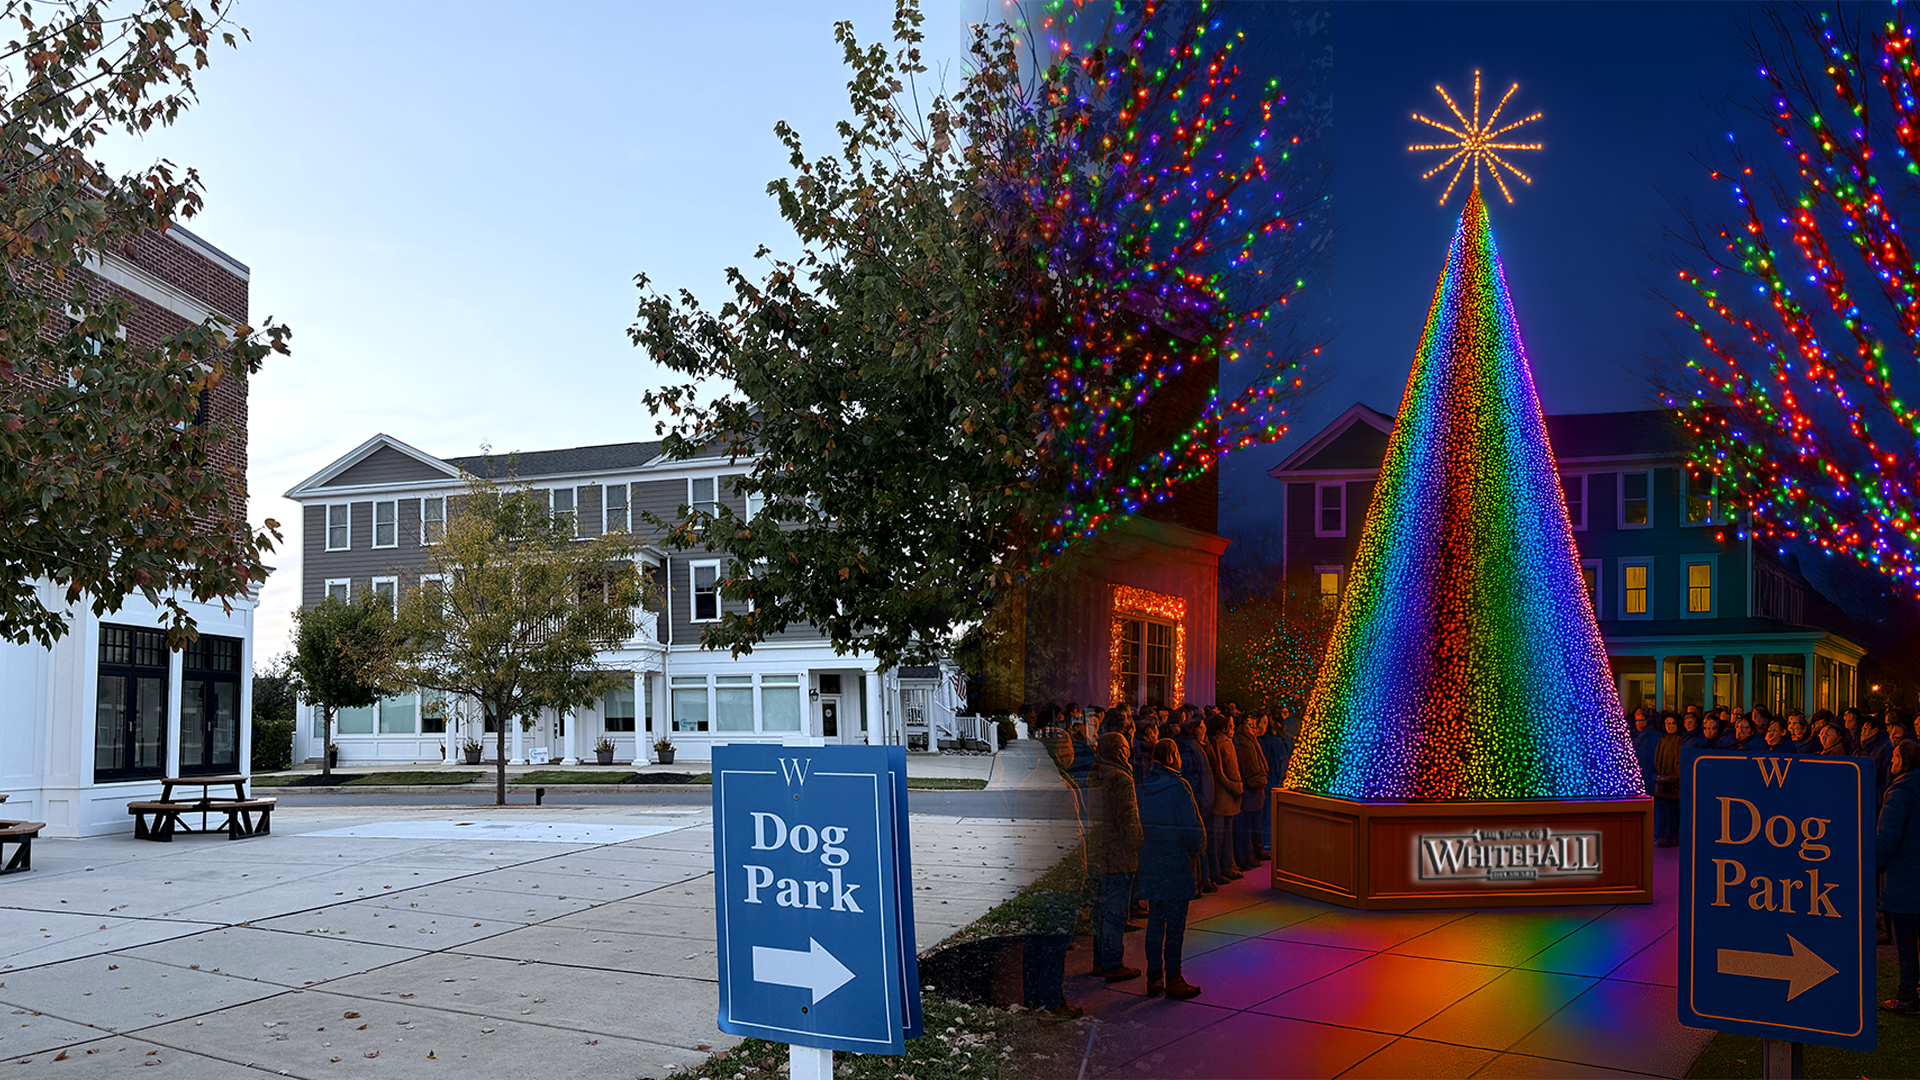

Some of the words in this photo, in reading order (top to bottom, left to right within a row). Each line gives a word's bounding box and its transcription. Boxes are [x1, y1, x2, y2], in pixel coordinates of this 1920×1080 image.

[778, 758, 812, 786] W
[1752, 757, 1793, 788] W
[750, 811, 850, 866] Dog
[1715, 796, 1831, 861] Dog
[1424, 836, 1599, 874] WHITEHALL
[742, 864, 864, 914] Park
[1710, 858, 1842, 918] Park
